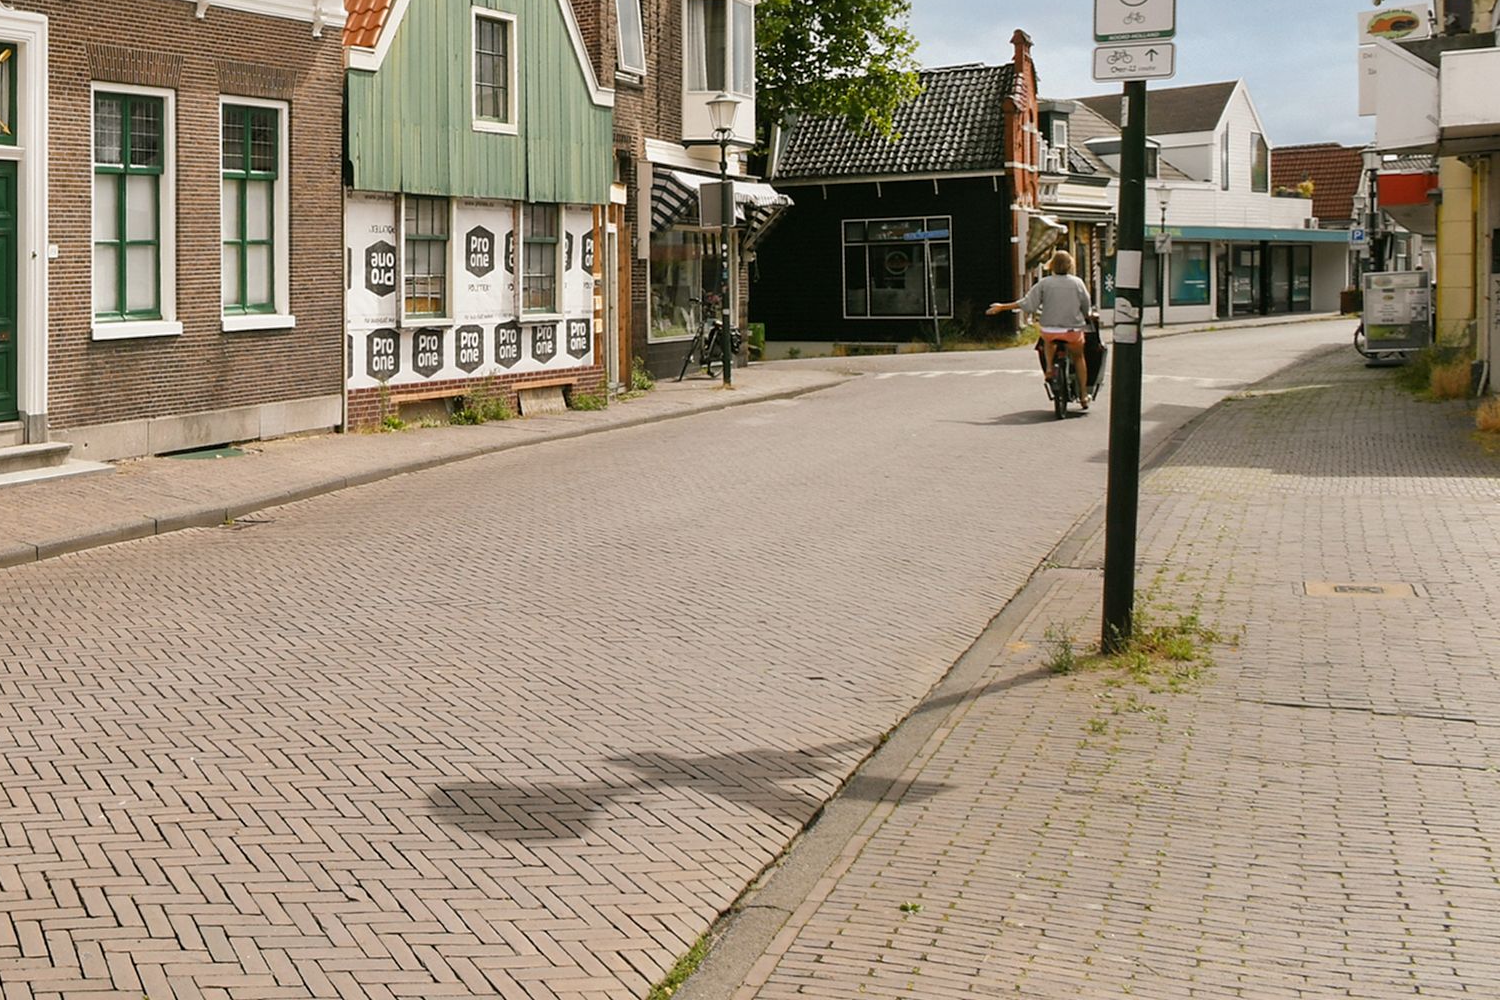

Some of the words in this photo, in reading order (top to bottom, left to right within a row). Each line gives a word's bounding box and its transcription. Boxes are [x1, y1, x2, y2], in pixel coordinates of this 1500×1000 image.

[470, 253, 489, 267] one
[536, 340, 553, 354] one
[570, 336, 586, 350] one
[460, 348, 479, 363] one
[500, 344, 517, 359] one
[372, 355, 395, 371] one
[418, 352, 438, 367] one
